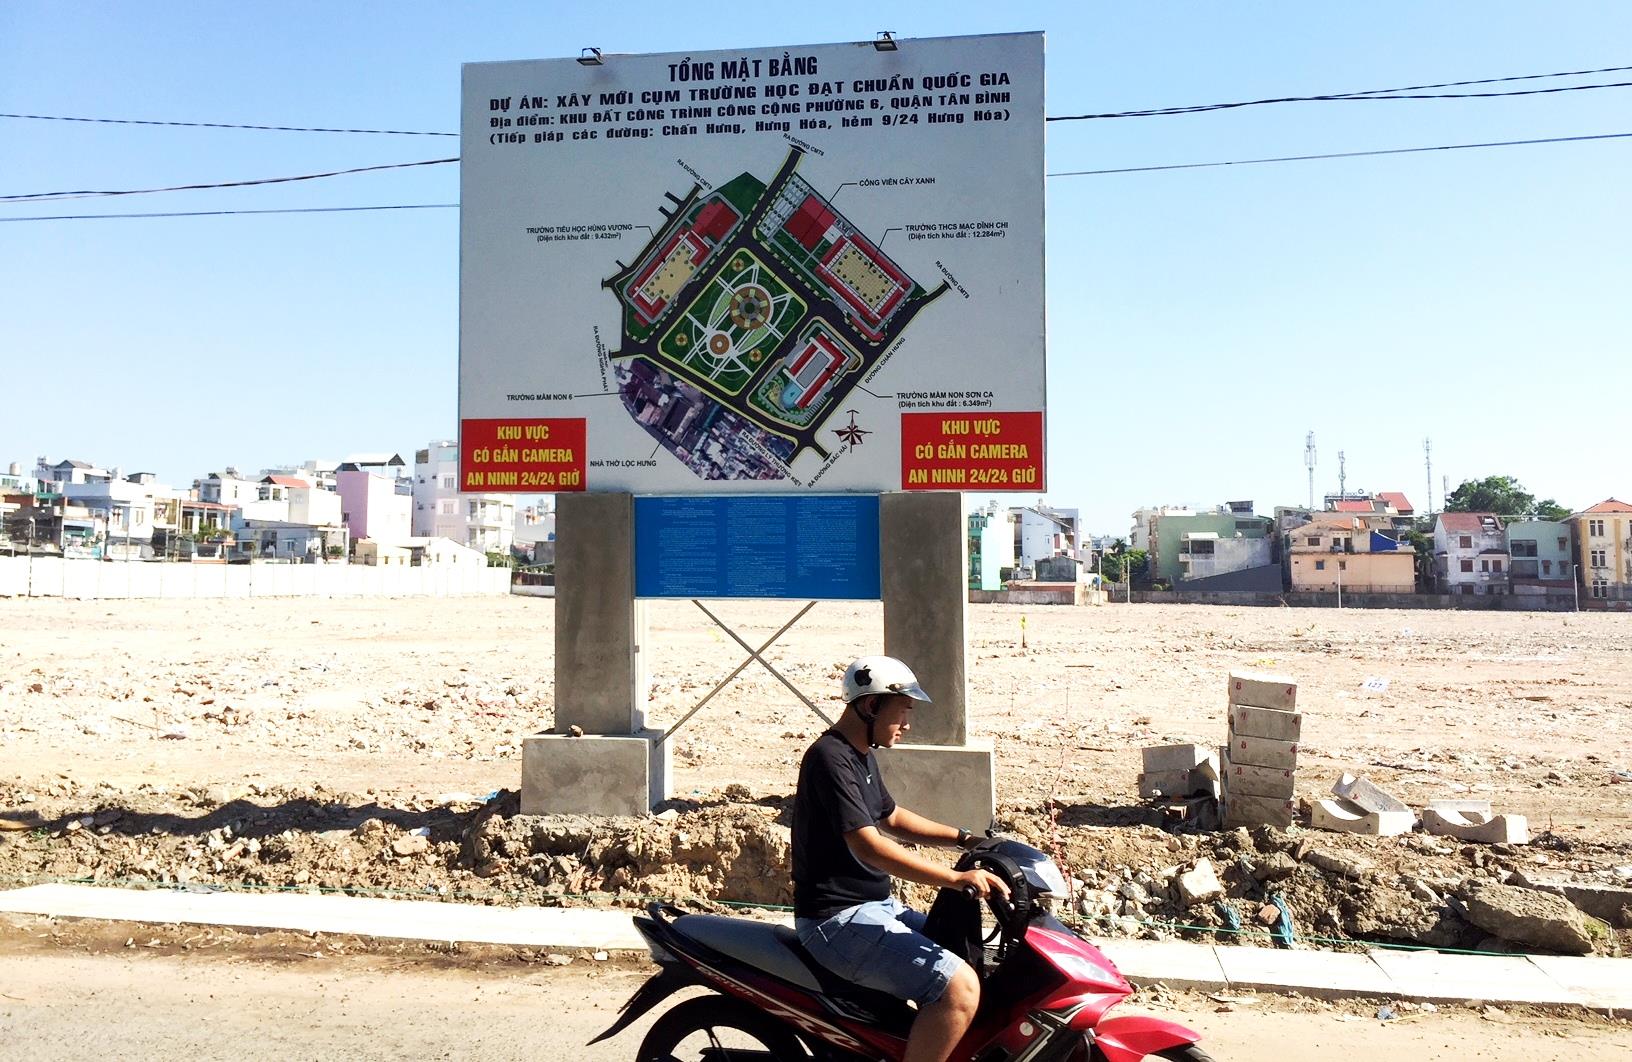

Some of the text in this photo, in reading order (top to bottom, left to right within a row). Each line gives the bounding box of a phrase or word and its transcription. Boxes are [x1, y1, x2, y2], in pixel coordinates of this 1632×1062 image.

[669, 52, 818, 82] TỔNG MẶT BẰNG
[490, 72, 1010, 112] DỰ ÁN: XÂY MỚI CỤM TRƯỜNG HỌC ĐẠT CHUẨN QUỐC GIA
[490, 92, 1010, 128] Địa điểm: KHU ĐẤT CÔNG TRÌNH CÔNG CỘNG PHƯỜNG 6, QUẬN TÂN BÌNH
[490, 110, 1010, 144] (Tiếp giáp các đường: Chấn Hưng, Hưng Hóa, hẻm 9/24 Hưng Hóa)
[677, 158, 686, 168] RA
[859, 178, 880, 187] CÔNG
[881, 177, 898, 186] VIÊN
[900, 176, 914, 185] CÂY
[526, 226, 554, 234] TRƯỜNG
[572, 226, 586, 234] HỌC
[588, 224, 606, 232] HÙNG
[906, 222, 936, 232] TRƯỜNG
[958, 222, 975, 231] MẠC
[976, 221, 994, 229] ĐÌNH
[537, 234, 553, 242] (Diện
[908, 232, 927, 240] (Diện
[928, 231, 940, 239] tích
[956, 230, 967, 238] đất
[936, 260, 943, 270] RA
[864, 364, 882, 384] ĐƯỜNG
[892, 337, 906, 353] HƯNG
[897, 391, 928, 399] TRƯỜNG
[946, 399, 957, 407] đất
[497, 425, 549, 442] KHU VỰC
[942, 418, 1000, 438] KHU VỰC
[473, 447, 488, 462] CÓ
[522, 450, 573, 462] CAMERA
[916, 442, 933, 459] CÓ
[970, 444, 1028, 458] CAMERA
[590, 459, 604, 467] NHÀ
[606, 459, 620, 467] THỜ
[622, 460, 635, 468] LỌC
[467, 468, 580, 486] AN NINH 24/24 GIỜ
[807, 480, 815, 488] RA
[814, 464, 831, 482] ĐƯỜNG
[908, 465, 1036, 483] AN NINH 24/24 GIỜ
